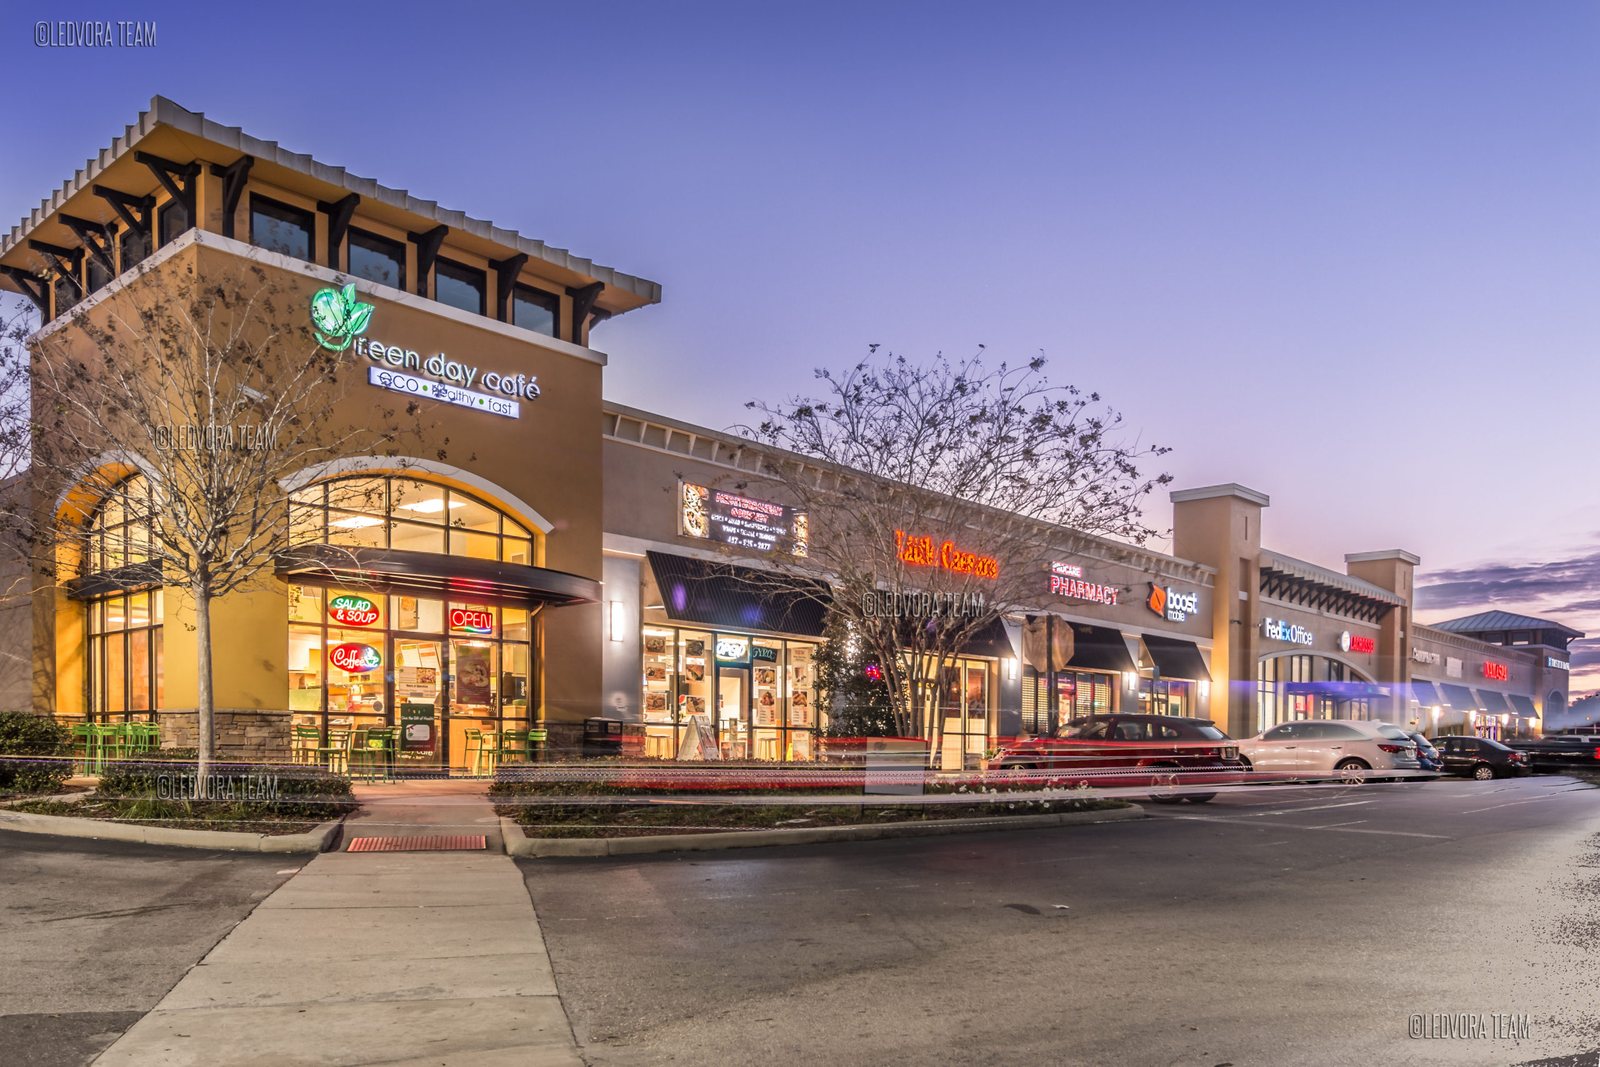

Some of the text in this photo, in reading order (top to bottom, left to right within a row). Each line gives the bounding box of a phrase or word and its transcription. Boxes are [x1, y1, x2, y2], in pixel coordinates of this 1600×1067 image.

[425, 352, 477, 388] day
[483, 371, 541, 402] café
[488, 398, 512, 415] fast
[1049, 574, 1119, 606] PHARMACY
[334, 597, 371, 612] SALAD
[1167, 587, 1198, 614] boost
[336, 611, 377, 624] & SOUP
[452, 610, 492, 629] OPEN
[1167, 609, 1185, 622] mobile
[1265, 617, 1313, 646] FedEx Office
[333, 647, 366, 669] Coffee
